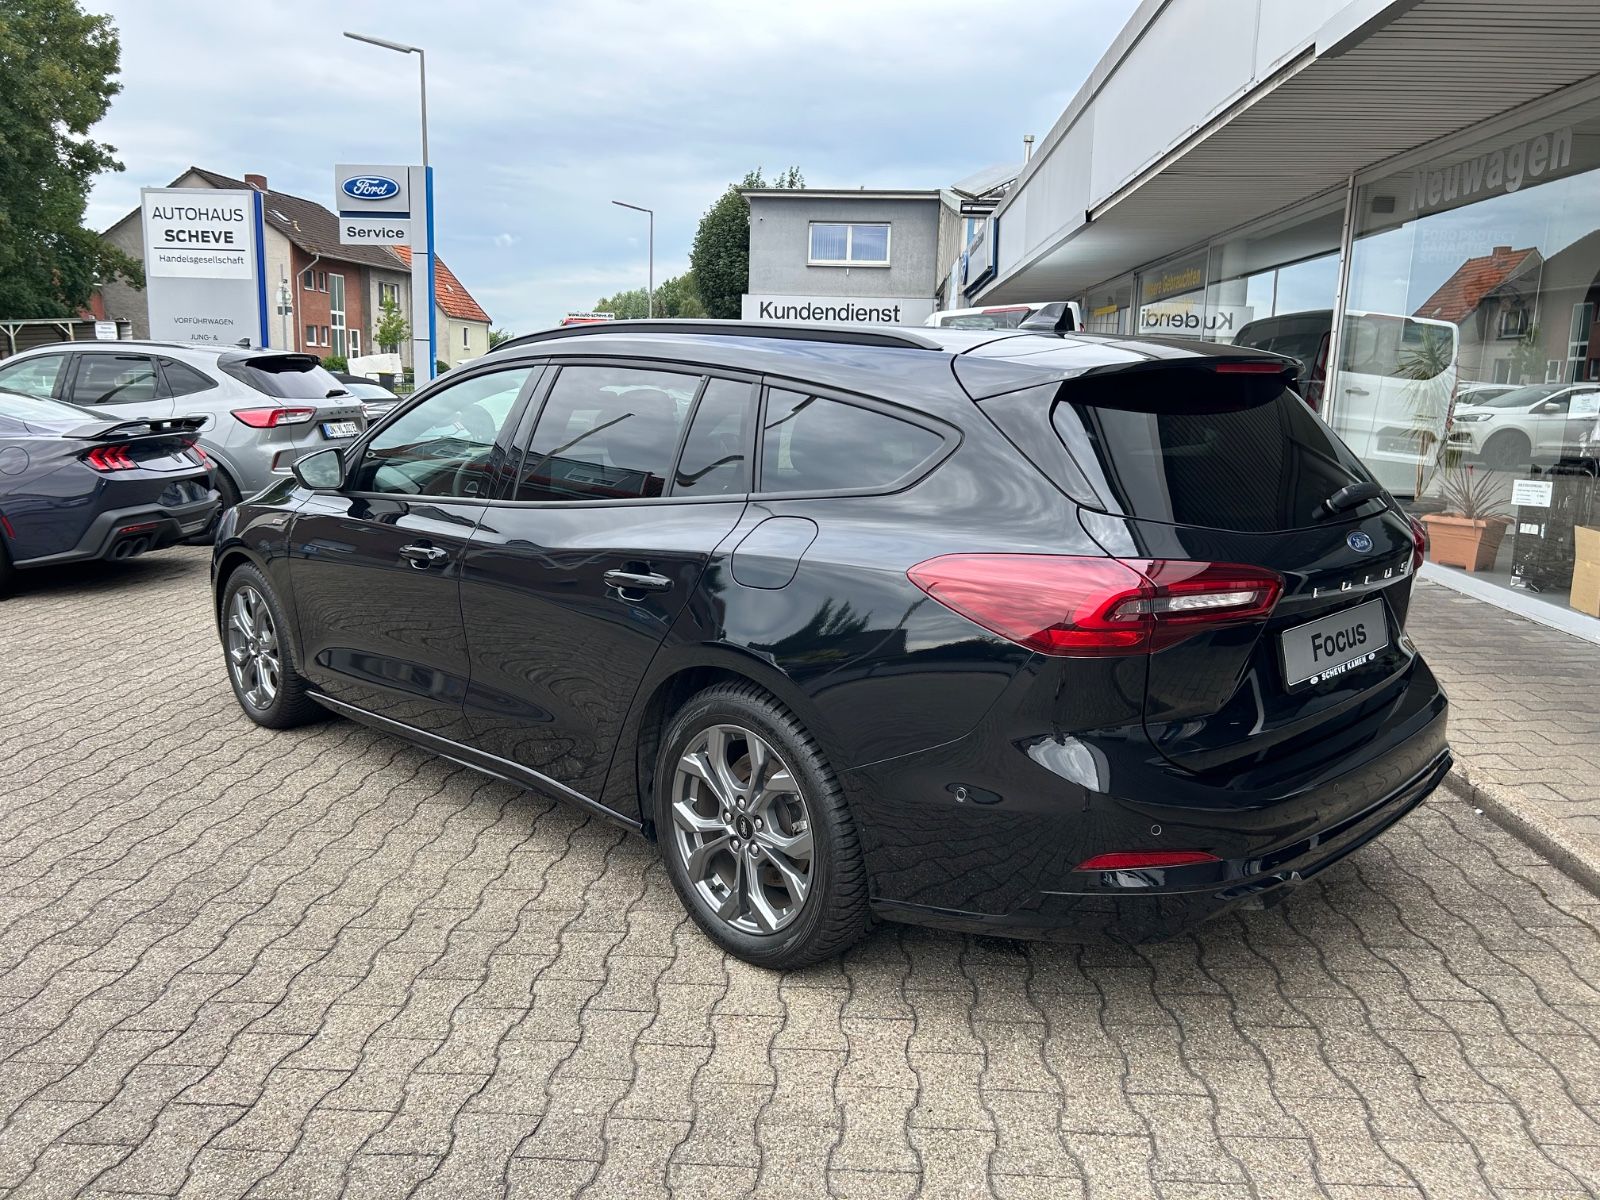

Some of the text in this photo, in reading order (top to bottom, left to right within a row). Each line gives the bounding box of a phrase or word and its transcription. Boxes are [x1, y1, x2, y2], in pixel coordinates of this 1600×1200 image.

[1409, 127, 1573, 211] Neuwagen
[353, 179, 388, 195] Ford
[152, 206, 244, 222] AUTOHAUS
[164, 229, 234, 244] SCHEVE
[346, 226, 405, 239] Service
[159, 254, 245, 265] Handelsgesellschaft
[759, 301, 901, 323] Kundendienst
[174, 316, 234, 326] VORFÜHRWAGEN
[1311, 623, 1367, 662] Focus
[1321, 655, 1367, 681] SCHEVE KAMEN
